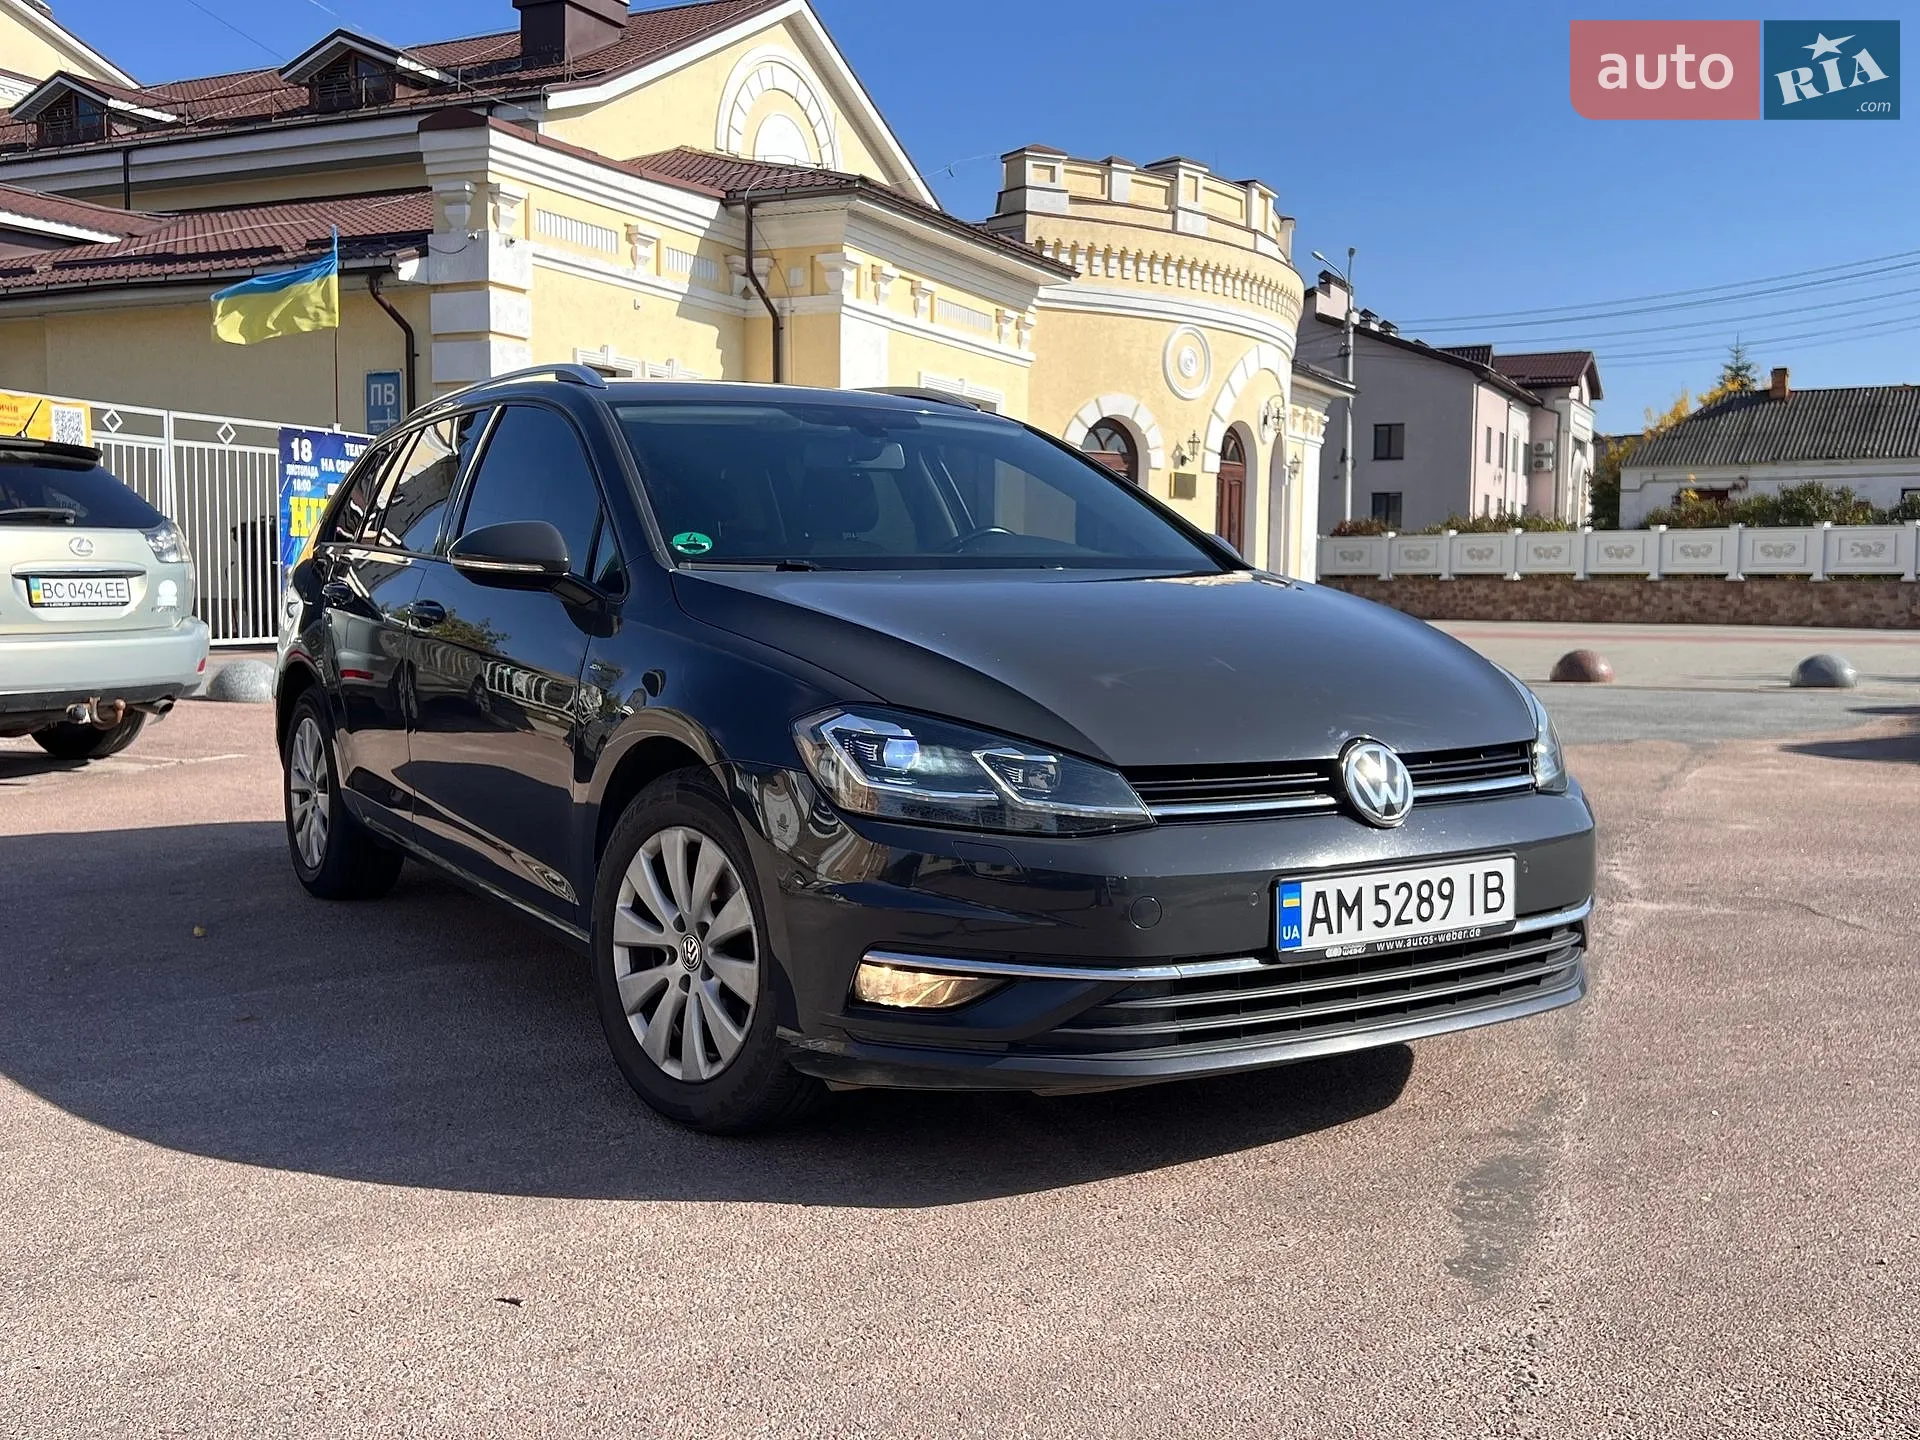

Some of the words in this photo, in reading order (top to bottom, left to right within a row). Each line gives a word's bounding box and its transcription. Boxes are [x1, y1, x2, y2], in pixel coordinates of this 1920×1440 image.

[370, 383, 396, 406] ПВ
[291, 437, 312, 462] 18
[320, 457, 335, 473] НА
[42, 582, 65, 599] BC
[68, 582, 102, 599] 0494
[105, 582, 126, 598] EE
[1308, 886, 1363, 937] AM
[1372, 876, 1455, 928] 5289
[1468, 871, 1505, 916] IB
[1282, 927, 1300, 940] UA
[1376, 927, 1481, 951] www.autos-weber.de
